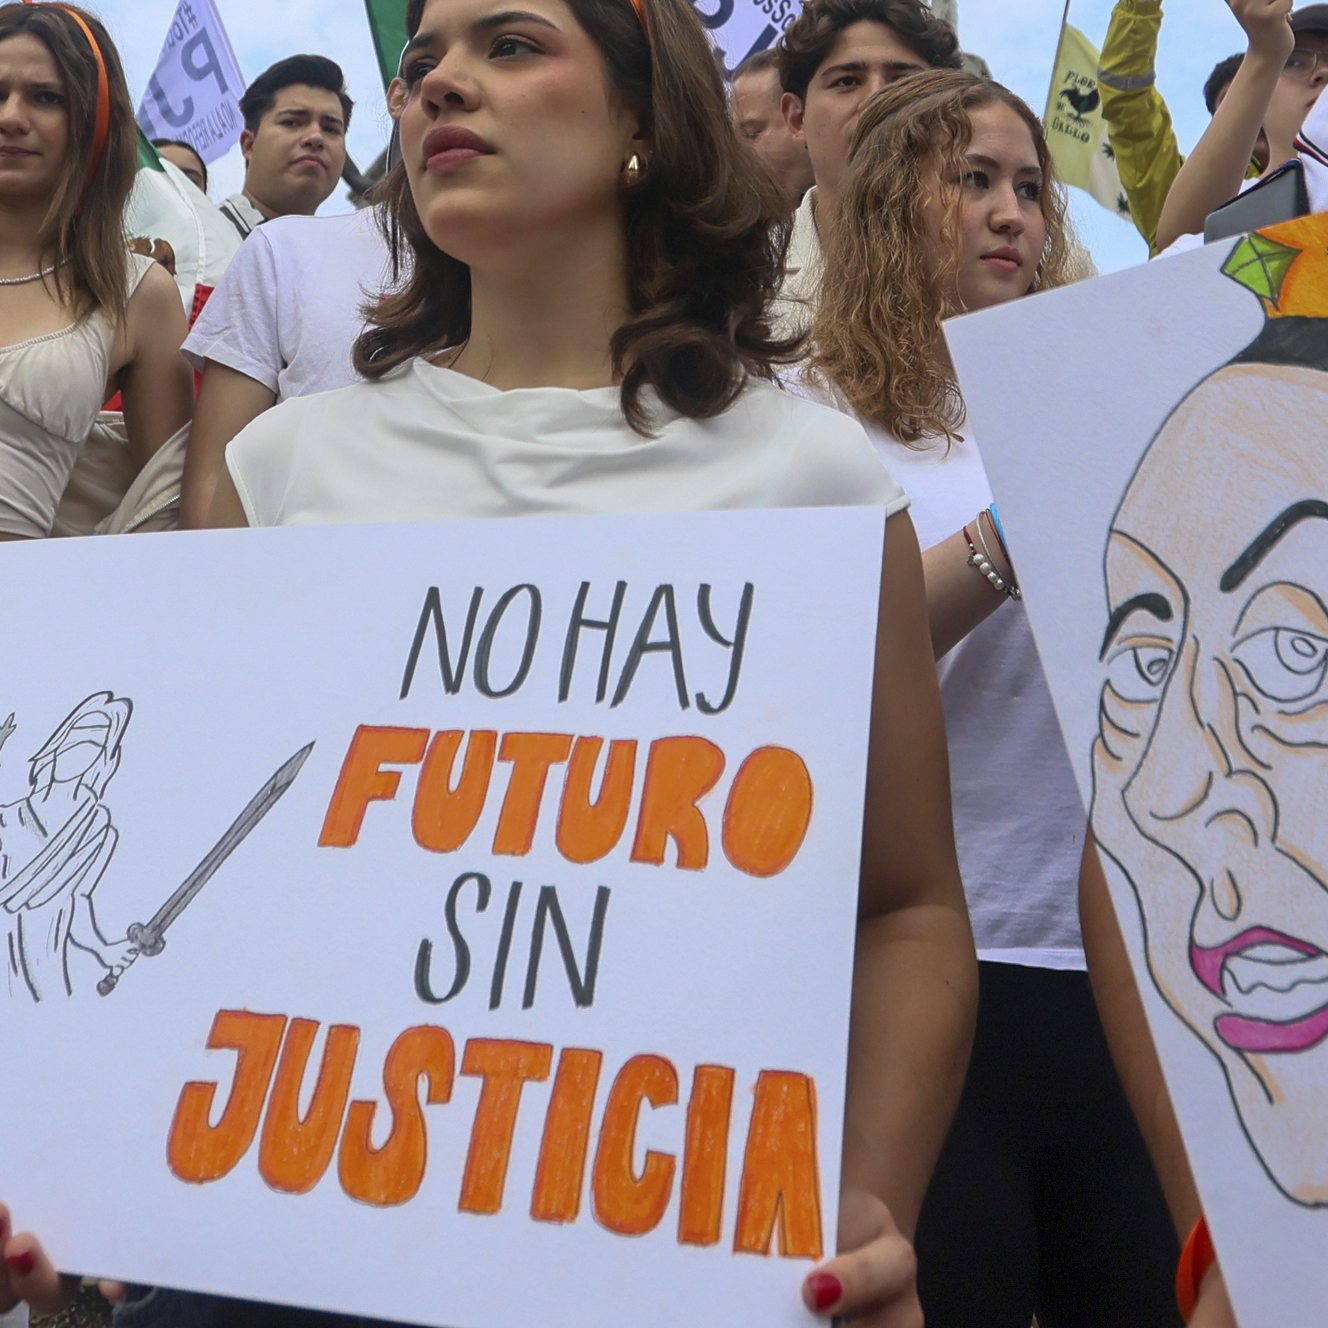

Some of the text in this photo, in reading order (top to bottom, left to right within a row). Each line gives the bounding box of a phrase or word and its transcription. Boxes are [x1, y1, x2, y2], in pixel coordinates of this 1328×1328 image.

[400, 580, 754, 715] NO HAY
[317, 724, 814, 878] FUTURO
[414, 872, 611, 1011] SIN
[166, 1009, 825, 1260] JUSTICIA
